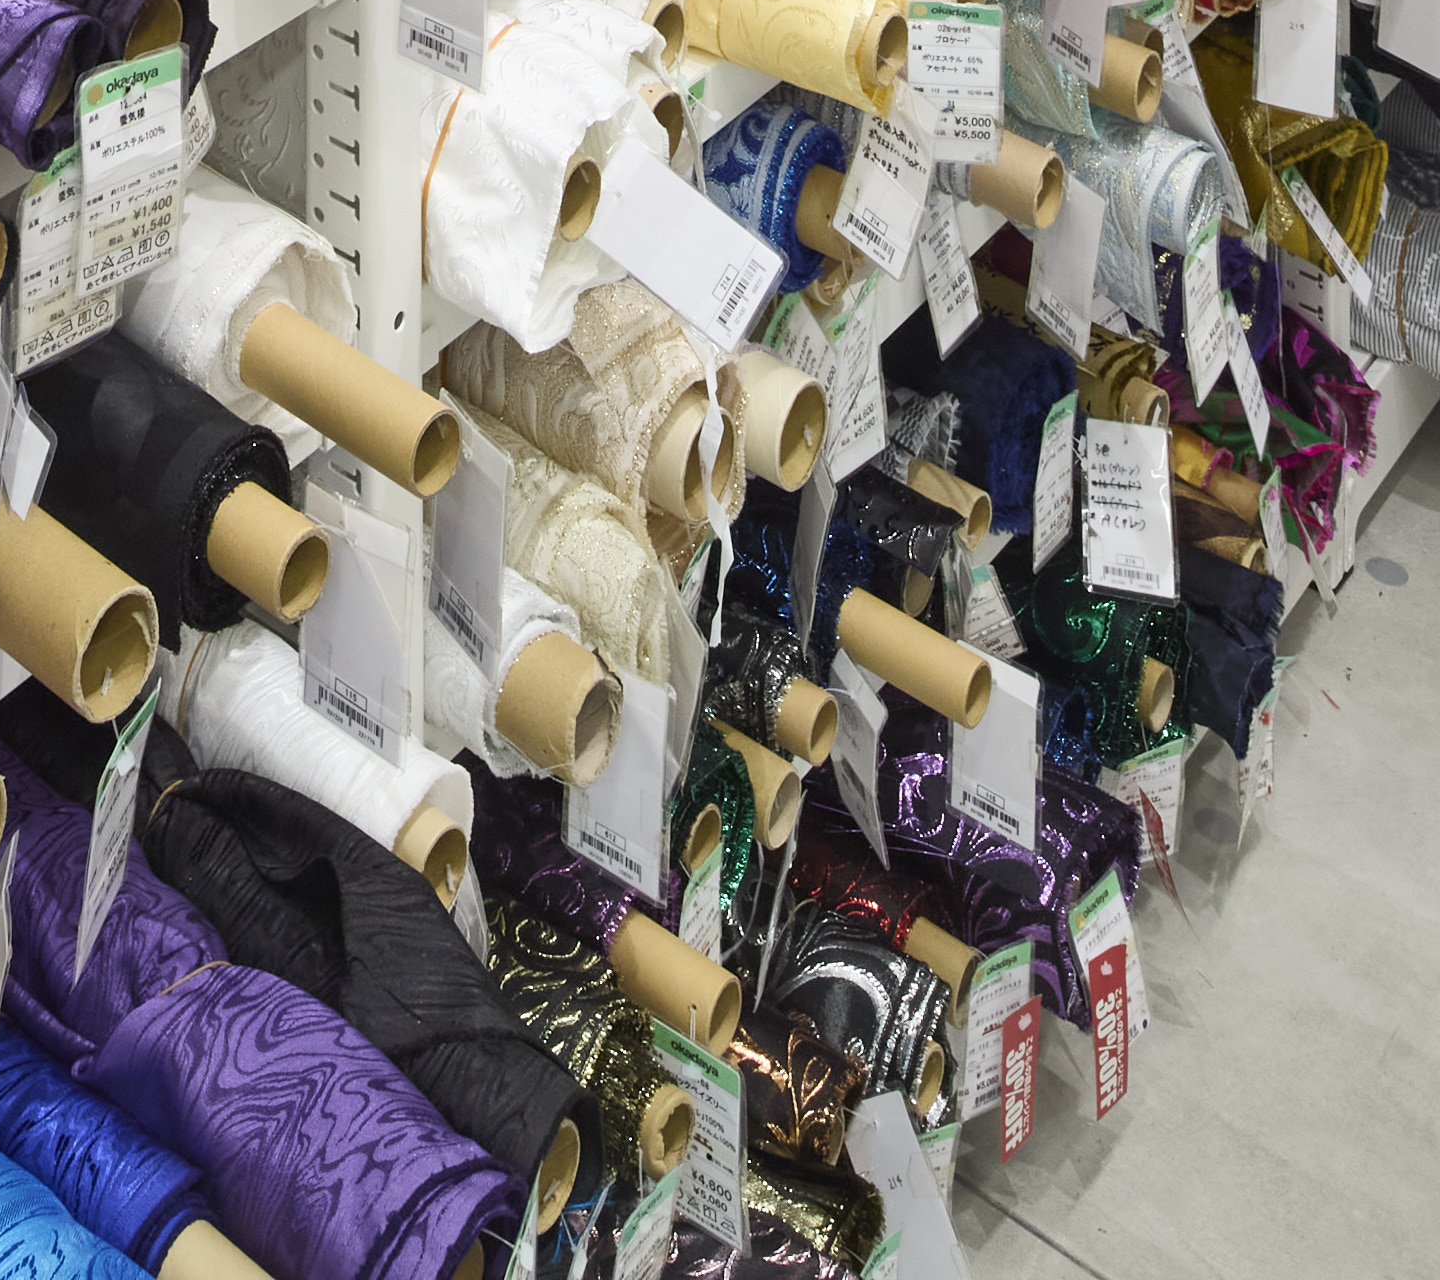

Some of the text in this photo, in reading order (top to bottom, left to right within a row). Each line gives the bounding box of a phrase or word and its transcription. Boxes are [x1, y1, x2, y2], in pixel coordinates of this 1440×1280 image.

[930, 5, 980, 19] okadaya
[953, 116, 993, 129] ¥5,000
[953, 129, 992, 141] ¥5,500
[132, 194, 173, 222] ¥1,400
[131, 213, 172, 239] ¥1,540
[1096, 992, 1118, 1110] 30%OFF
[1005, 1042, 1026, 1153] 30%OFF
